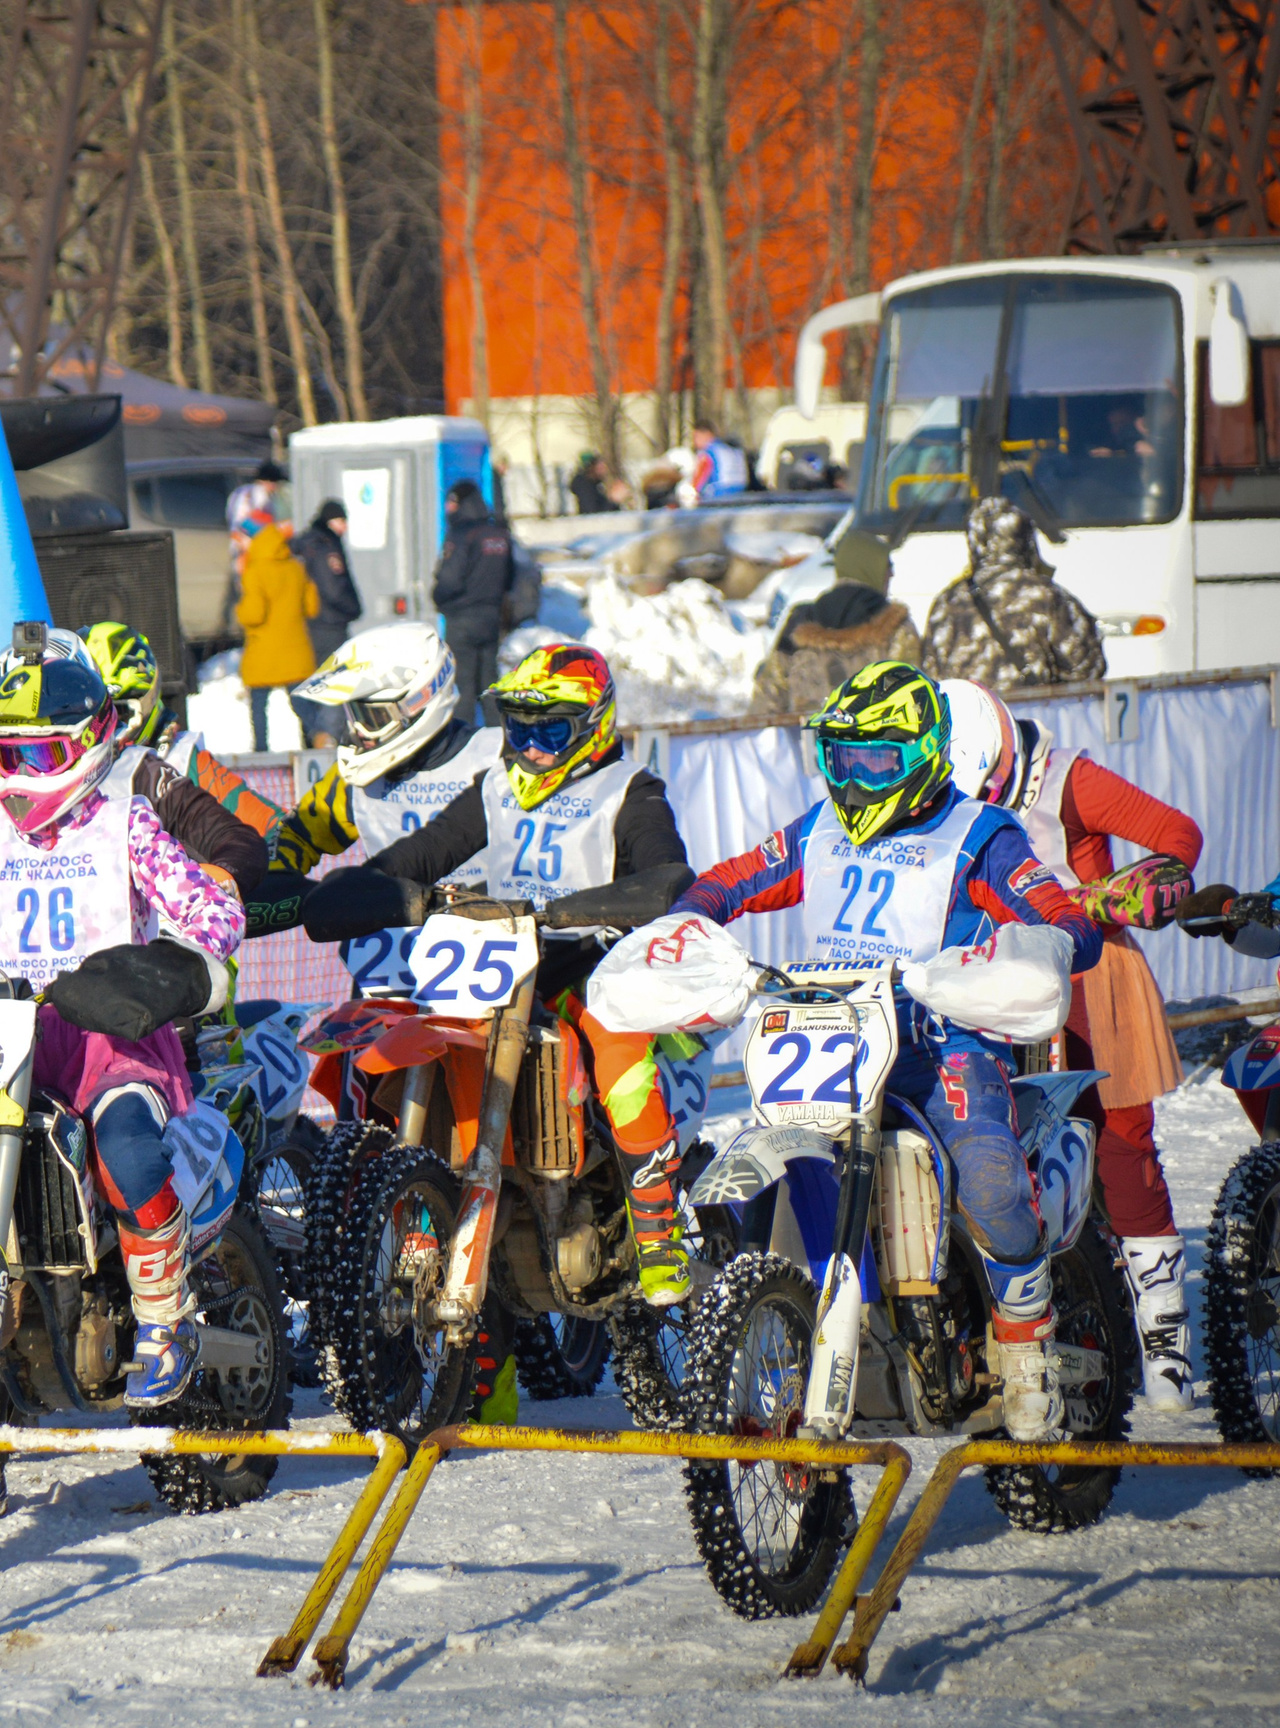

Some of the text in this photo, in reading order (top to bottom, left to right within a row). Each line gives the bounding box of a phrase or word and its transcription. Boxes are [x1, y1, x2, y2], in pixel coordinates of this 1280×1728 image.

[31, 690, 39, 713] SCOTT
[532, 802, 591, 818] КАЛОВА
[511, 818, 567, 882] 25
[855, 846, 926, 868] ЧКАЛОВА
[5, 853, 93, 870] МОТОКРОСС
[0, 865, 98, 881] В.П. ЧКАЛОВА
[832, 864, 896, 938] 22
[16, 886, 76, 953] 26
[860, 941, 913, 958] РОССИИ
[20, 958, 48, 969] ФСО
[51, 954, 87, 968] РОСС
[416, 939, 518, 1002] 25
[21, 969, 46, 979] ПАО
[790, 1024, 854, 1032] OSANUSHKOV
[760, 1032, 870, 1105] 22
[778, 1104, 835, 1122] YAMAHA
